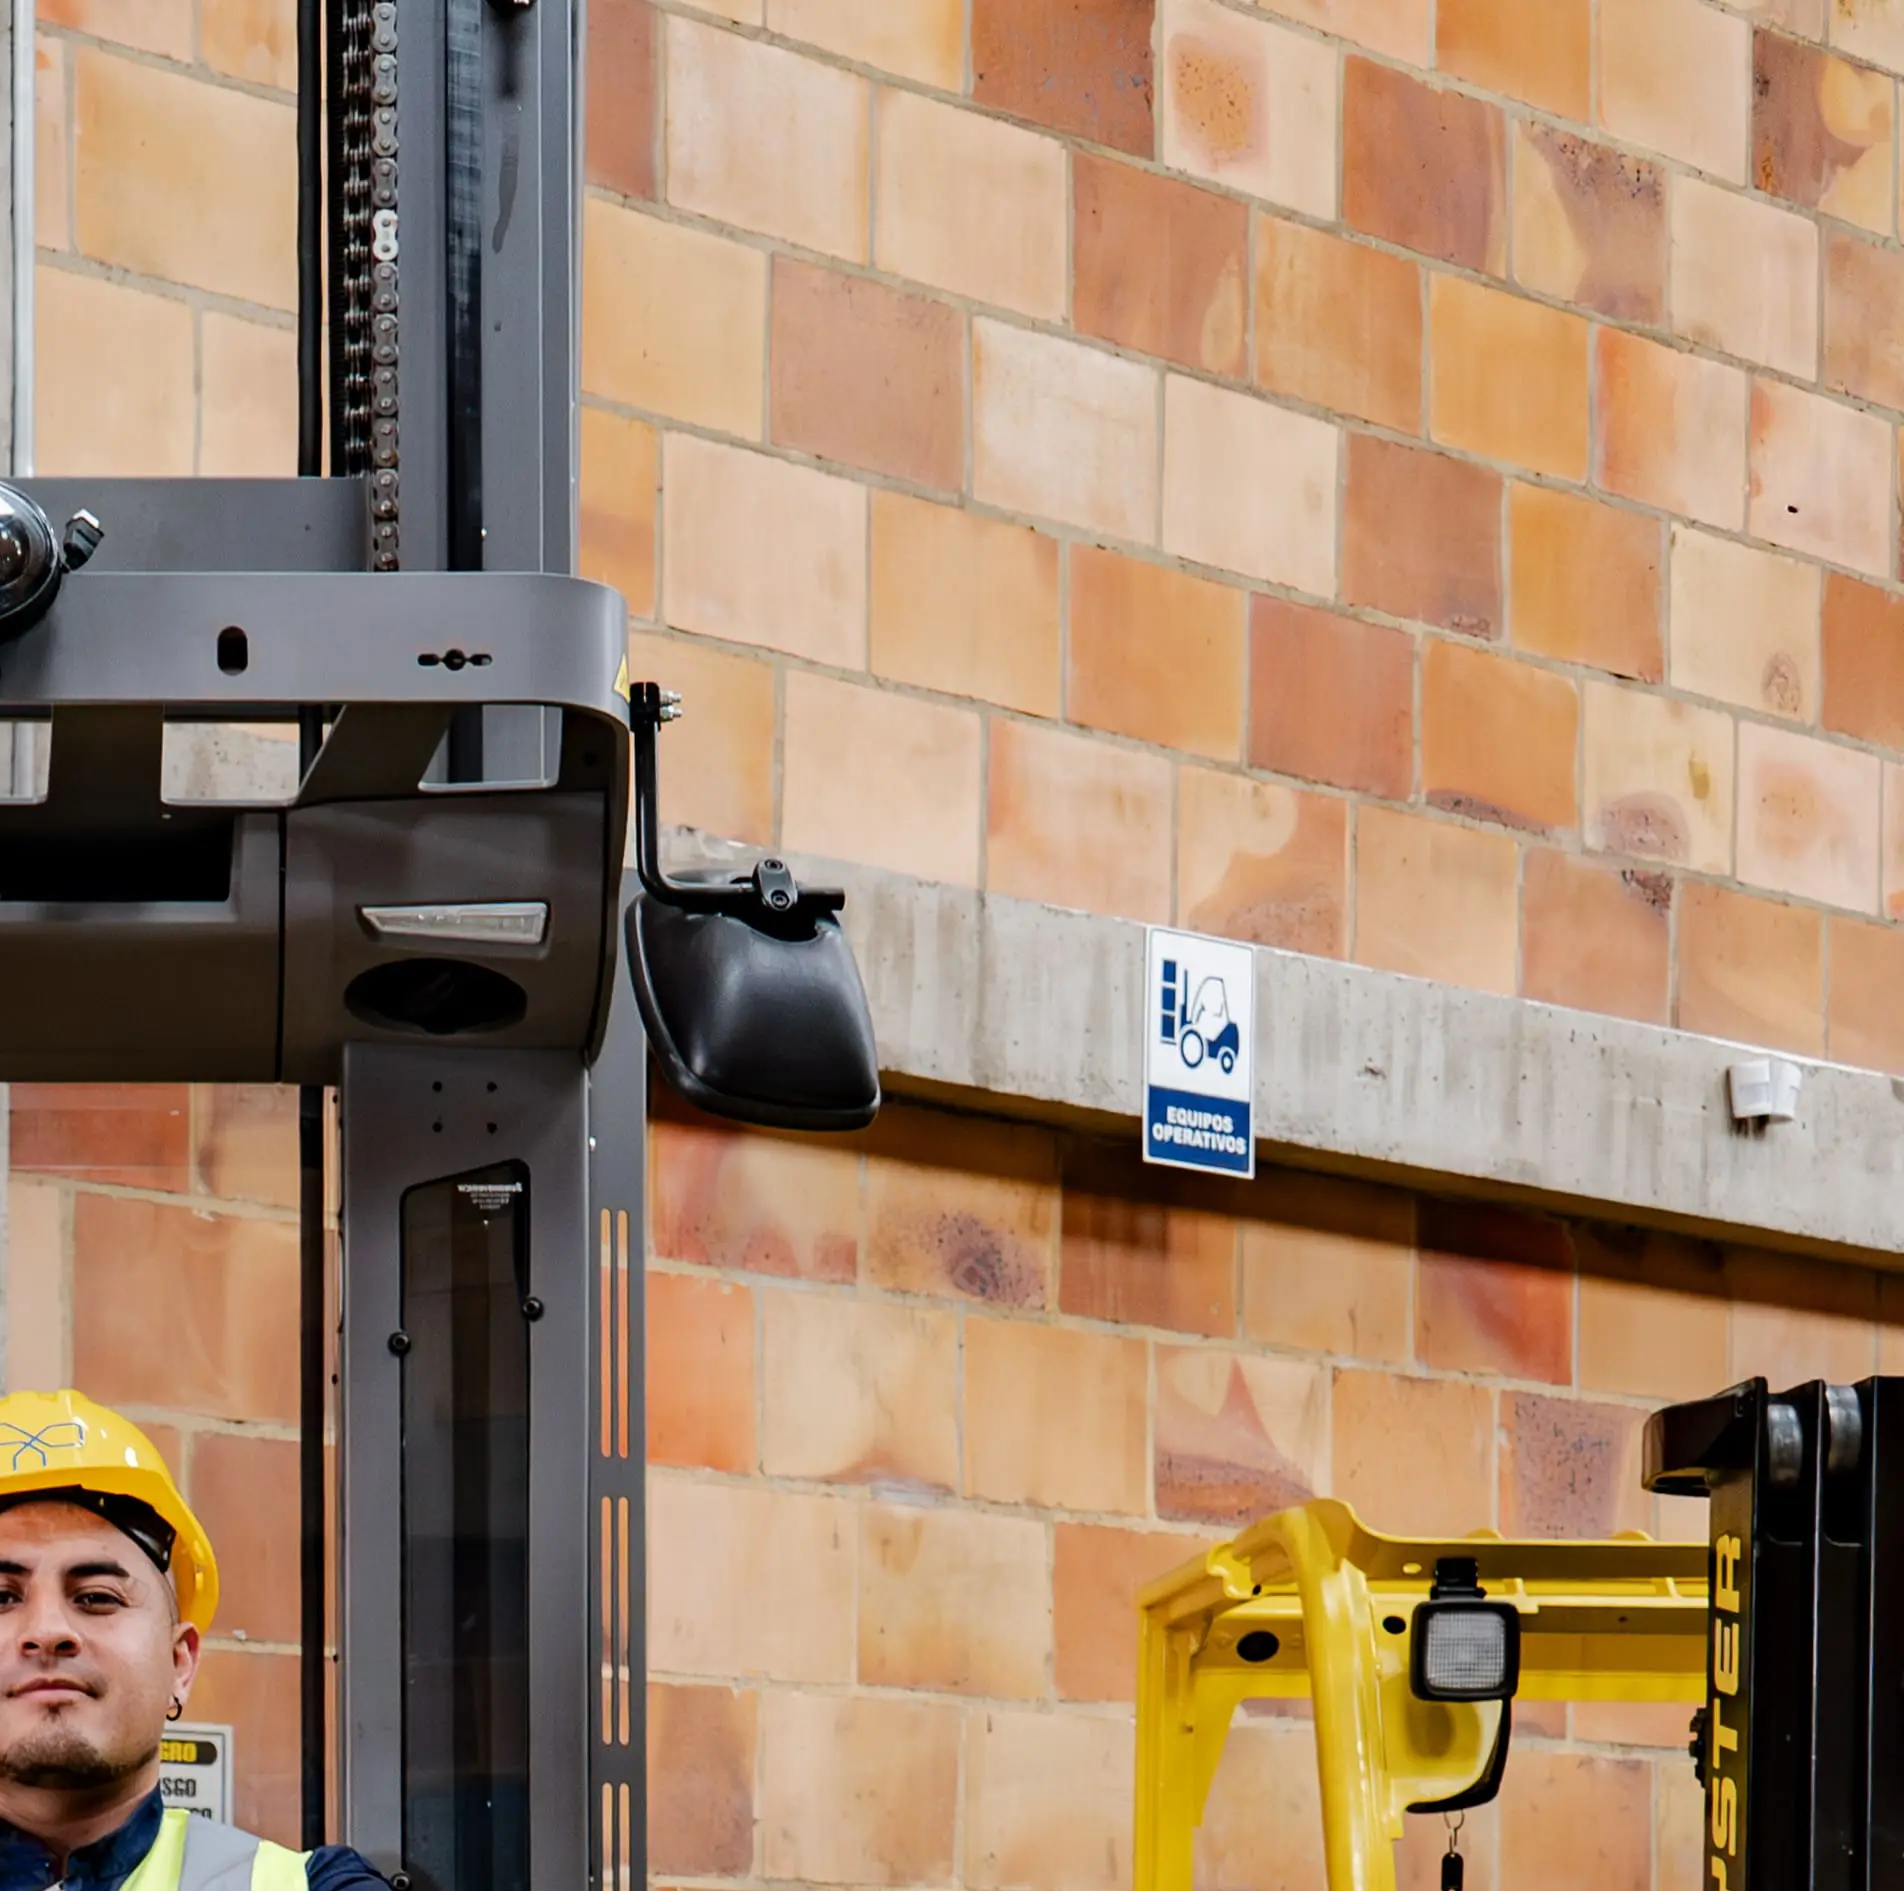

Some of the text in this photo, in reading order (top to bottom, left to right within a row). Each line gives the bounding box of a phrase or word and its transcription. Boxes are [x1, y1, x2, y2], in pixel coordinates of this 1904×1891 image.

[1167, 1106, 1233, 1133] EQUIPOS
[1153, 1123, 1246, 1155] OPERATIVOS
[162, 1777, 196, 1797] SGO
